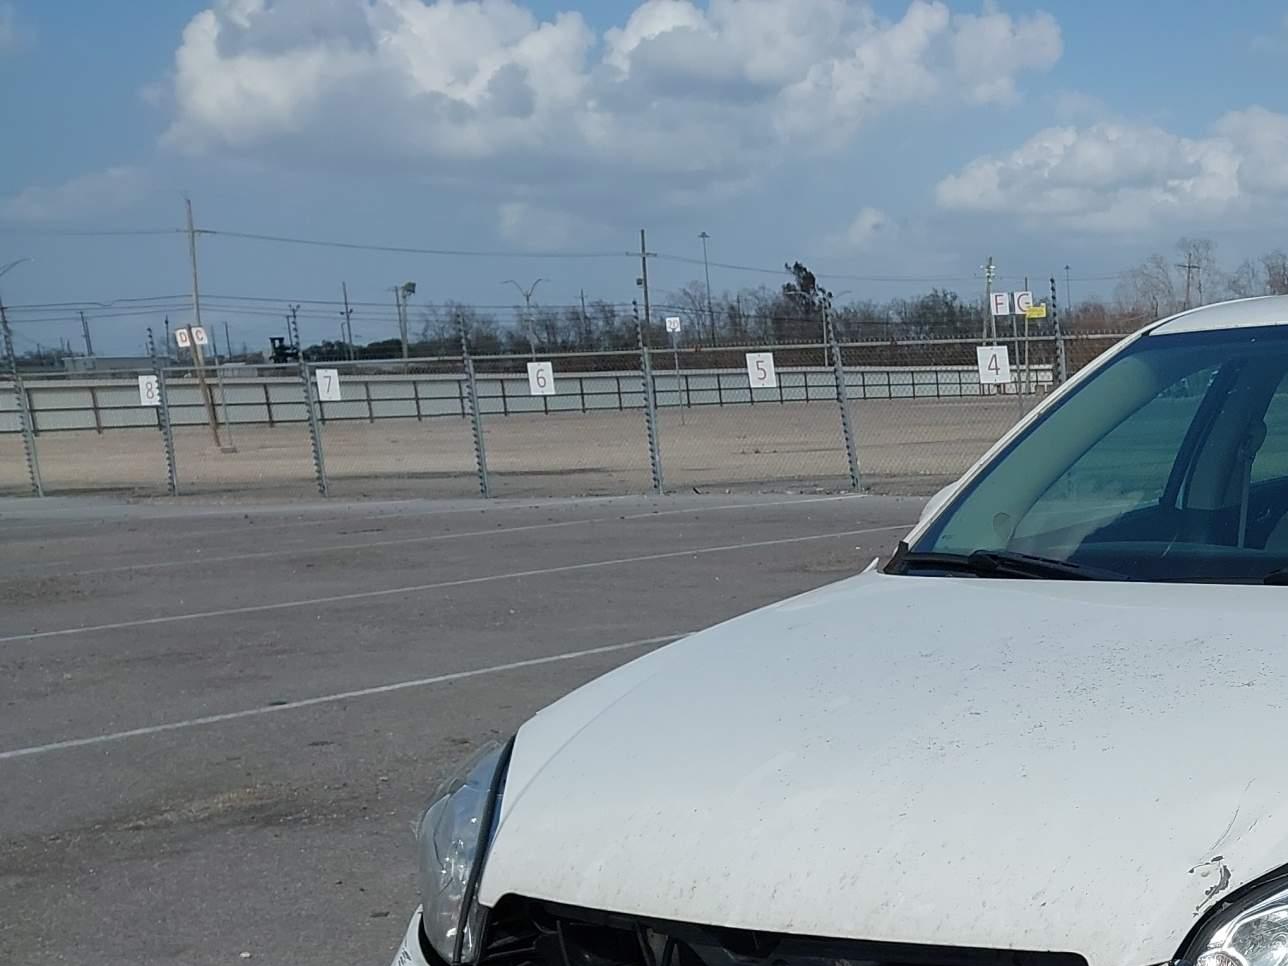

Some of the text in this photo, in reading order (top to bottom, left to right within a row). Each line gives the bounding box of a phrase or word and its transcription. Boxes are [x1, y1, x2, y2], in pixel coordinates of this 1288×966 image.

[995, 294, 1004, 314] F
[179, 332, 187, 343] D
[195, 330, 203, 341] C
[756, 360, 767, 380] 5
[988, 354, 1000, 375] 4
[322, 375, 332, 393] 7
[536, 368, 546, 388] 6
[145, 381, 154, 400] 8
